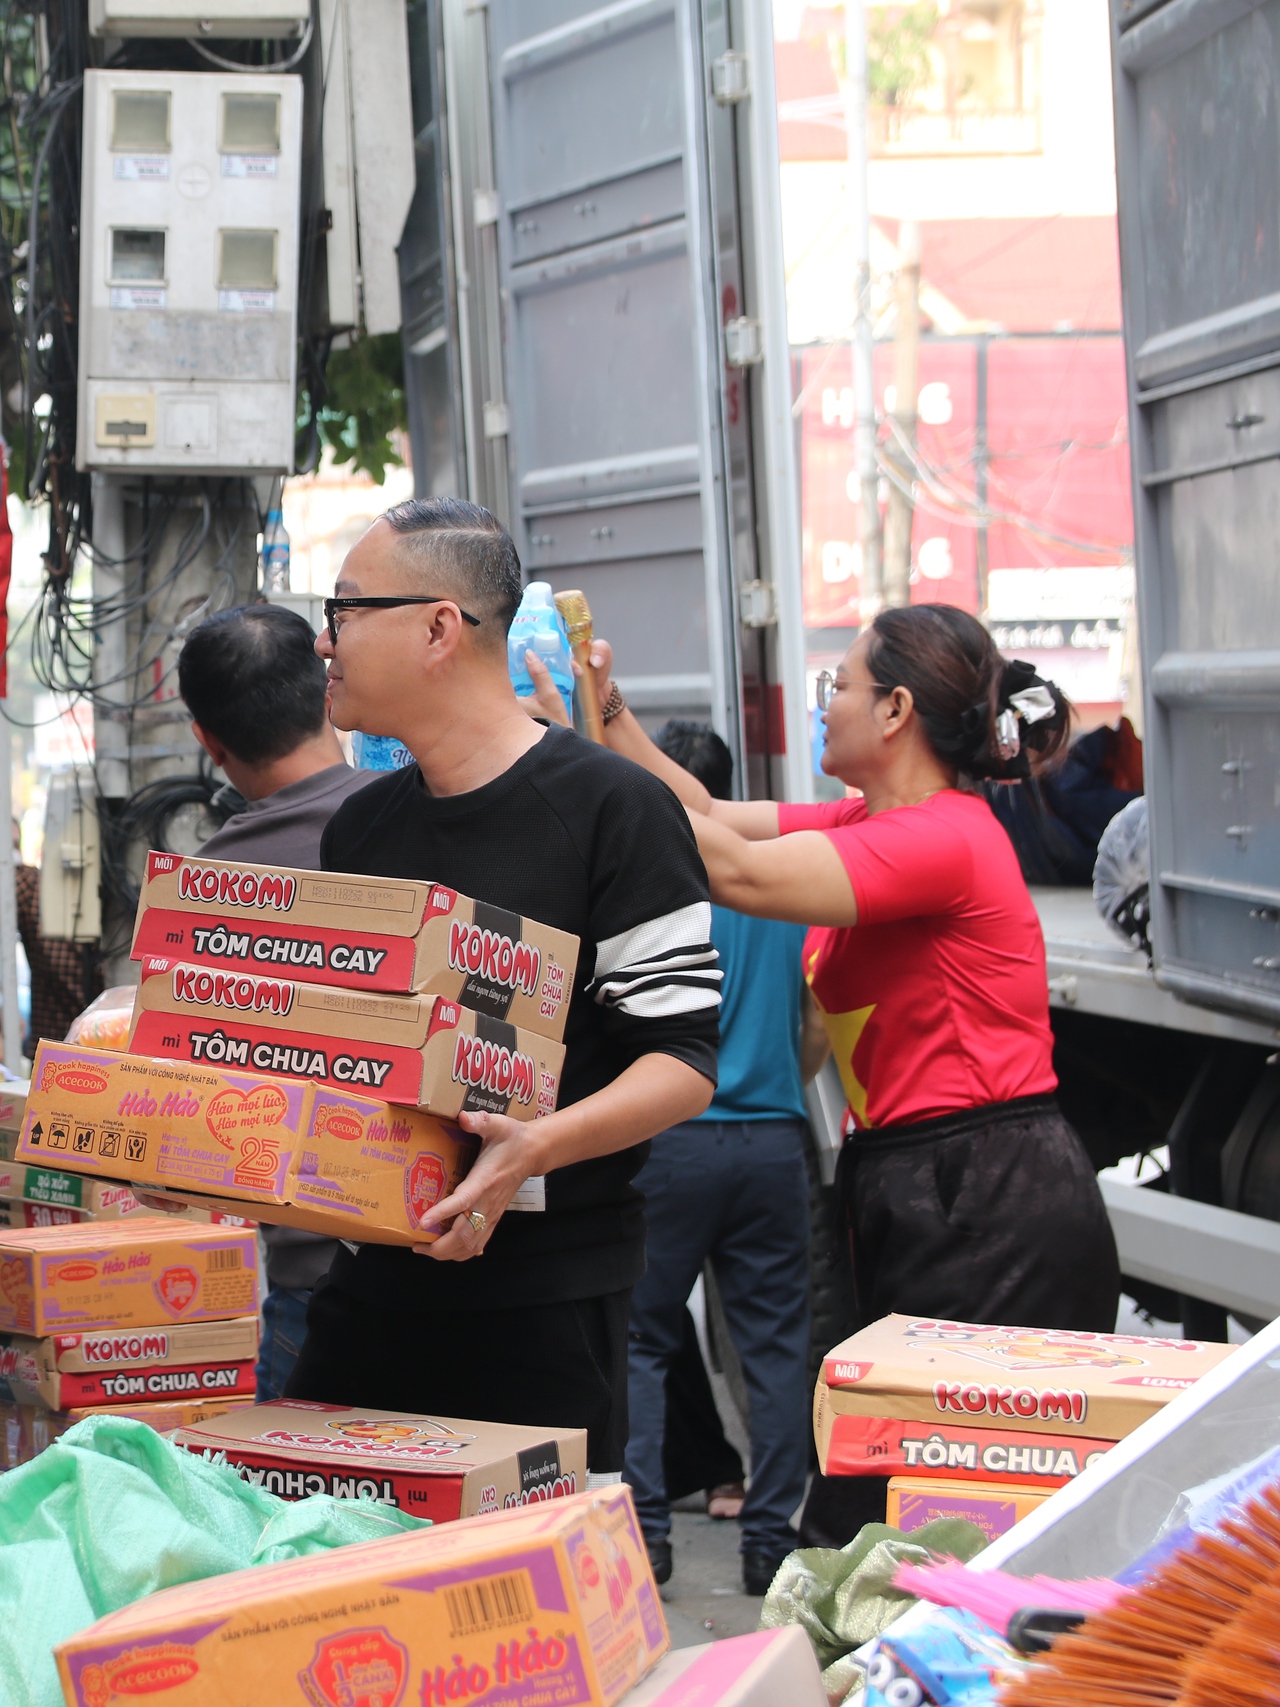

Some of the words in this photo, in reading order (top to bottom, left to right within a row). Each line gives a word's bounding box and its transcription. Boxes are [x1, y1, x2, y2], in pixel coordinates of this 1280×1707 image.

[154, 856, 173, 870] MỚI
[180, 866, 294, 911] KOKOMI
[166, 929, 184, 944] mì
[194, 927, 250, 957] TÔM
[254, 938, 323, 966] CHUA
[330, 950, 383, 972] CAY
[450, 922, 539, 993] KOKOMI
[148, 958, 168, 972] MỚI
[547, 963, 564, 982] TÔM
[175, 969, 291, 1012] KOKOMI
[541, 983, 562, 1001] CHUA
[540, 1002, 557, 1018] CAY
[58, 1062, 76, 1071] Cook
[78, 1061, 110, 1079] happiness
[162, 1033, 180, 1048] mì
[191, 1032, 247, 1062] TÔM
[254, 1049, 325, 1077] CHUA
[334, 1060, 389, 1085] CAY
[454, 1036, 533, 1101] KOKOMI
[120, 1063, 132, 1072] SẢN
[132, 1064, 148, 1075] PHẨM
[158, 1070, 174, 1080] CÔNG
[174, 1073, 190, 1083] NGHỆ
[191, 1075, 205, 1085] NHẬT
[541, 1071, 556, 1089] TÔM
[117, 1089, 158, 1117] Hảo
[159, 1089, 200, 1118] Hảo
[207, 1099, 233, 1116] Hảo
[237, 1097, 260, 1114] mọi
[538, 1092, 554, 1109] CHUA
[216, 1115, 237, 1130] Hảo
[241, 1115, 260, 1129] mọi
[328, 1104, 342, 1114] Cook
[342, 1105, 364, 1124] happiness
[366, 1117, 388, 1142] Hảo
[389, 1118, 411, 1143] Hảo
[192, 1149, 212, 1161] CHUA
[214, 1153, 230, 1164] CAY
[236, 1137, 280, 1177] 25
[32, 1207, 51, 1227] 30
[102, 1257, 125, 1275] Hảo
[128, 1251, 150, 1269] Hảo
[83, 1335, 167, 1363] KOKOMI
[102, 1375, 145, 1395] TÔM
[148, 1372, 199, 1391] CHUA
[202, 1369, 238, 1387] CAY
[834, 1362, 860, 1379] MỚI
[936, 1383, 1083, 1421] KOKOMI
[266, 1430, 455, 1456] KOKOMI
[866, 1440, 889, 1458] mì
[901, 1434, 976, 1467] TÔM
[982, 1446, 1078, 1475] CHUA
[247, 1469, 325, 1496] CHUA
[221, 1630, 241, 1642] SẢN
[242, 1621, 270, 1638] PHẨM
[291, 1611, 319, 1626] CÔNG
[321, 1606, 348, 1622] NGHỆ
[105, 1652, 133, 1674] Cook
[134, 1641, 195, 1661] happiness
[329, 1645, 357, 1658] Cung
[419, 1654, 489, 1706] Hảo
[494, 1627, 565, 1683] Hảo
